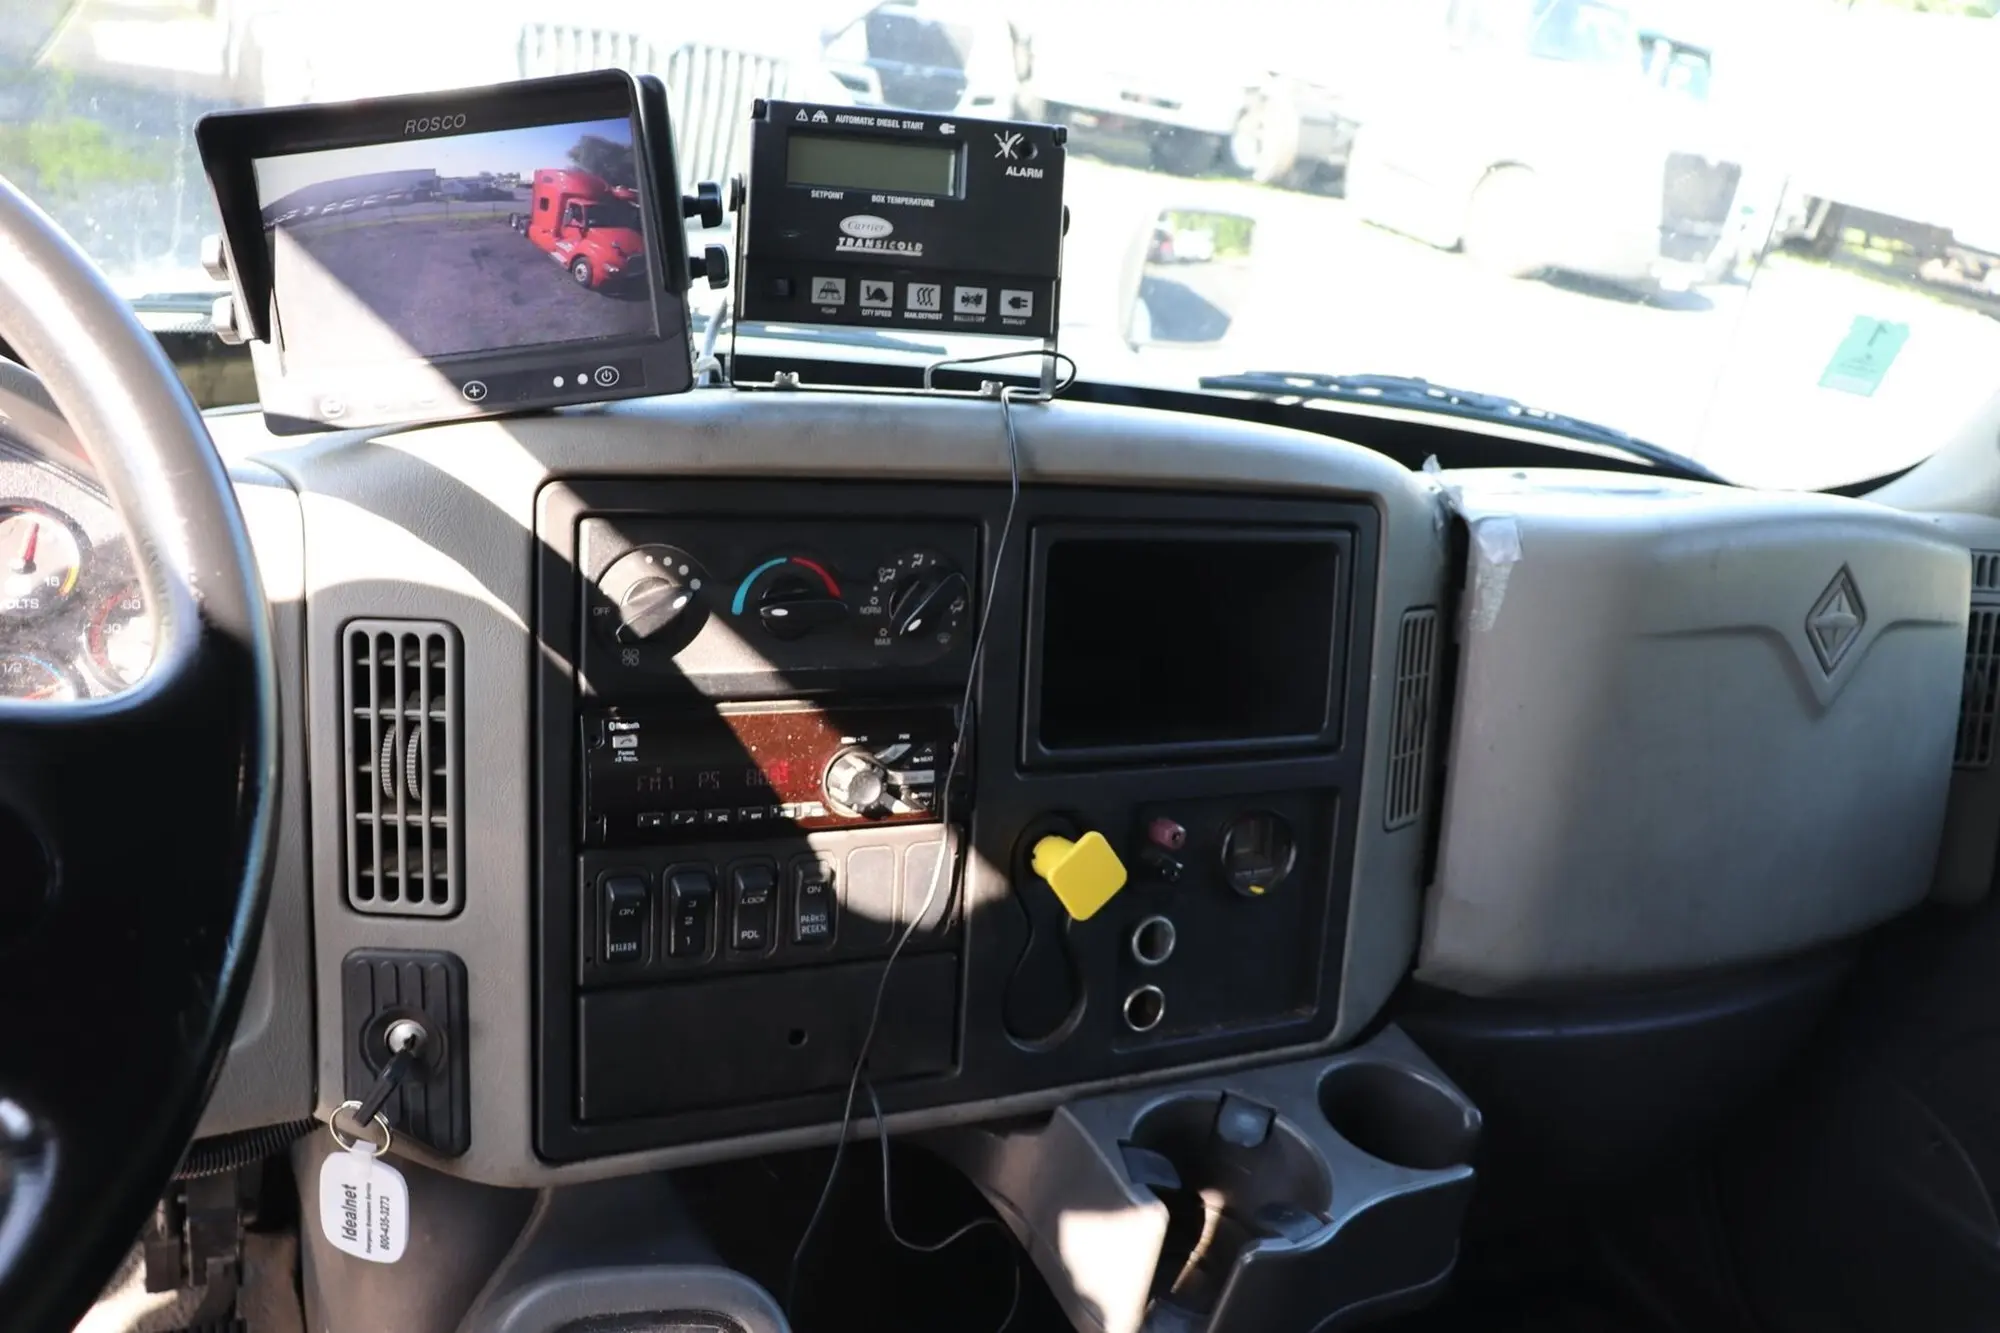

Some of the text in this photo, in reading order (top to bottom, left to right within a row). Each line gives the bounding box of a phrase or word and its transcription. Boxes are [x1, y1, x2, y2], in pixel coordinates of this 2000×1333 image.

[404, 113, 466, 134] ROSCO
[835, 114, 924, 131] AUTOMATIC DIESEL START
[1005, 166, 1044, 178] ALARM
[811, 189, 844, 200] SETPOINT
[871, 194, 935, 207] BOX TEMPERATURE
[846, 220, 885, 232] Carrier
[837, 237, 923, 252] TRANSICOLD
[861, 309, 892, 318] CITY SPEED
[593, 606, 610, 616] OFF
[859, 605, 882, 615] NORM
[874, 637, 891, 646] MAX
[807, 885, 822, 894] ON
[741, 930, 760, 940] PDL
[341, 1183, 357, 1242] Idealnet
